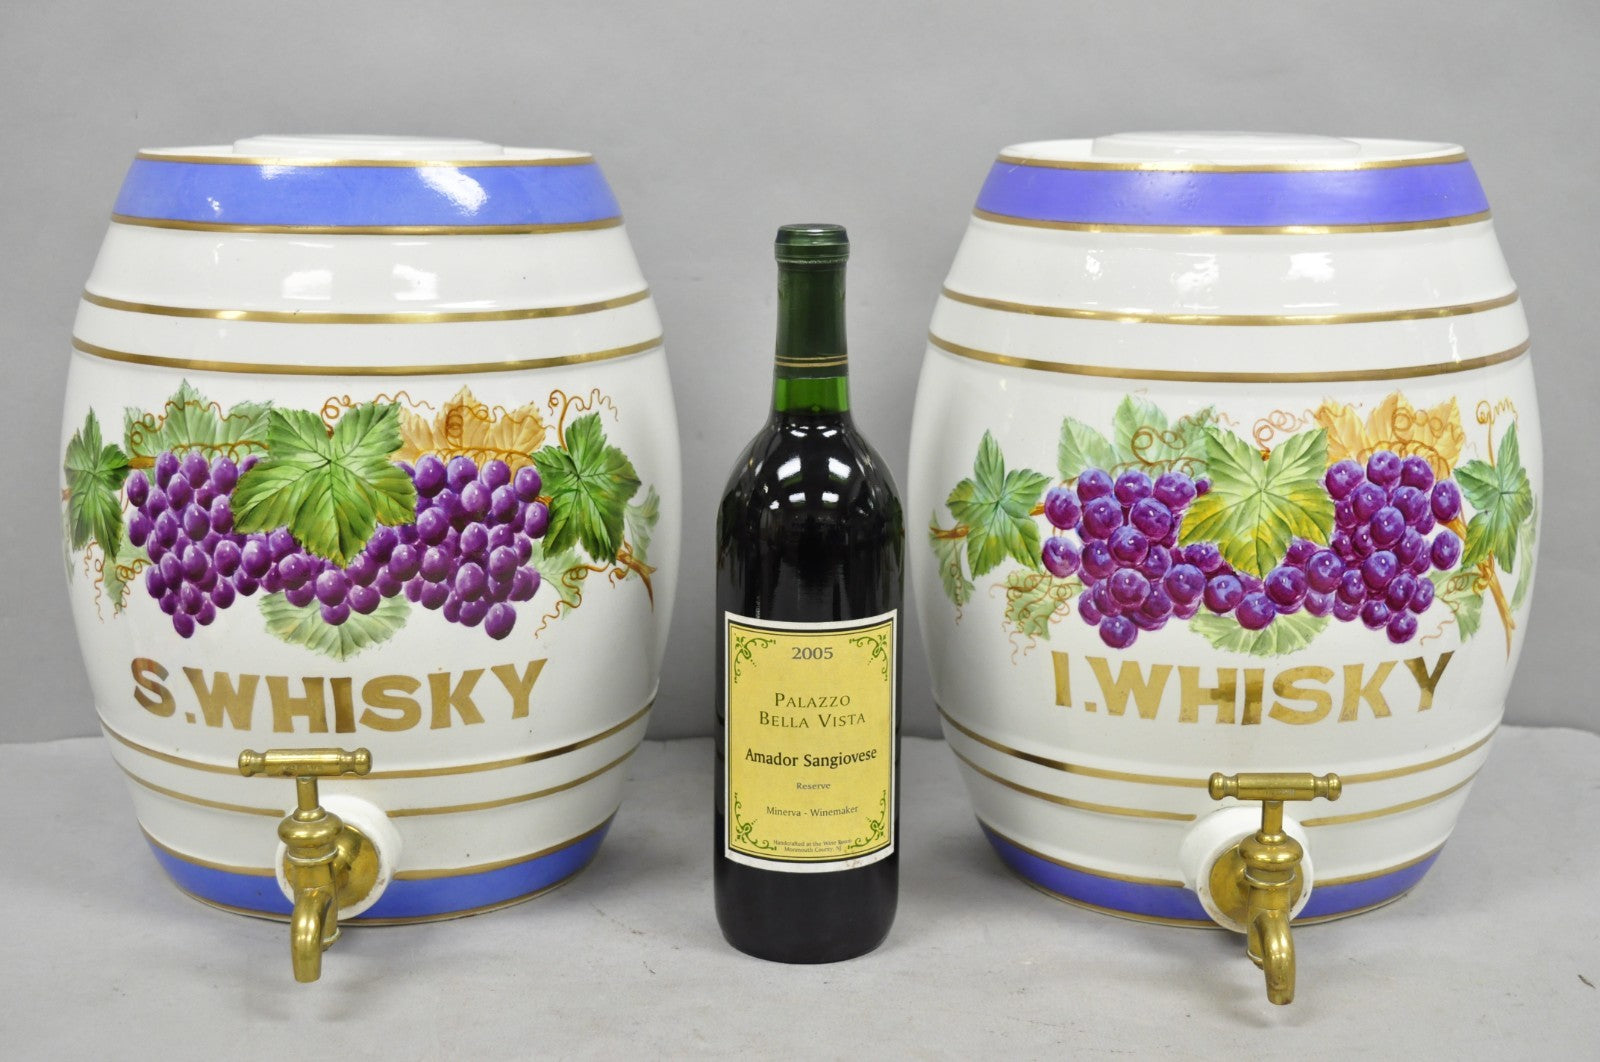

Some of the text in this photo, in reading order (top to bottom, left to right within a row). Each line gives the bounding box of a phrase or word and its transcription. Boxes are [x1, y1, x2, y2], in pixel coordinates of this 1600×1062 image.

[792, 647, 834, 660] 2005
[131, 657, 548, 734] S.WHISKY
[1051, 650, 1455, 726] I.WHISKY
[775, 692, 851, 708] PALAZZO
[759, 711, 866, 728] BELLA VISTA
[745, 748, 877, 769] Amador Sangiovese
[796, 782, 831, 790] Reserve
[766, 806, 801, 817] Minerva
[810, 806, 858, 817] Winemaker
